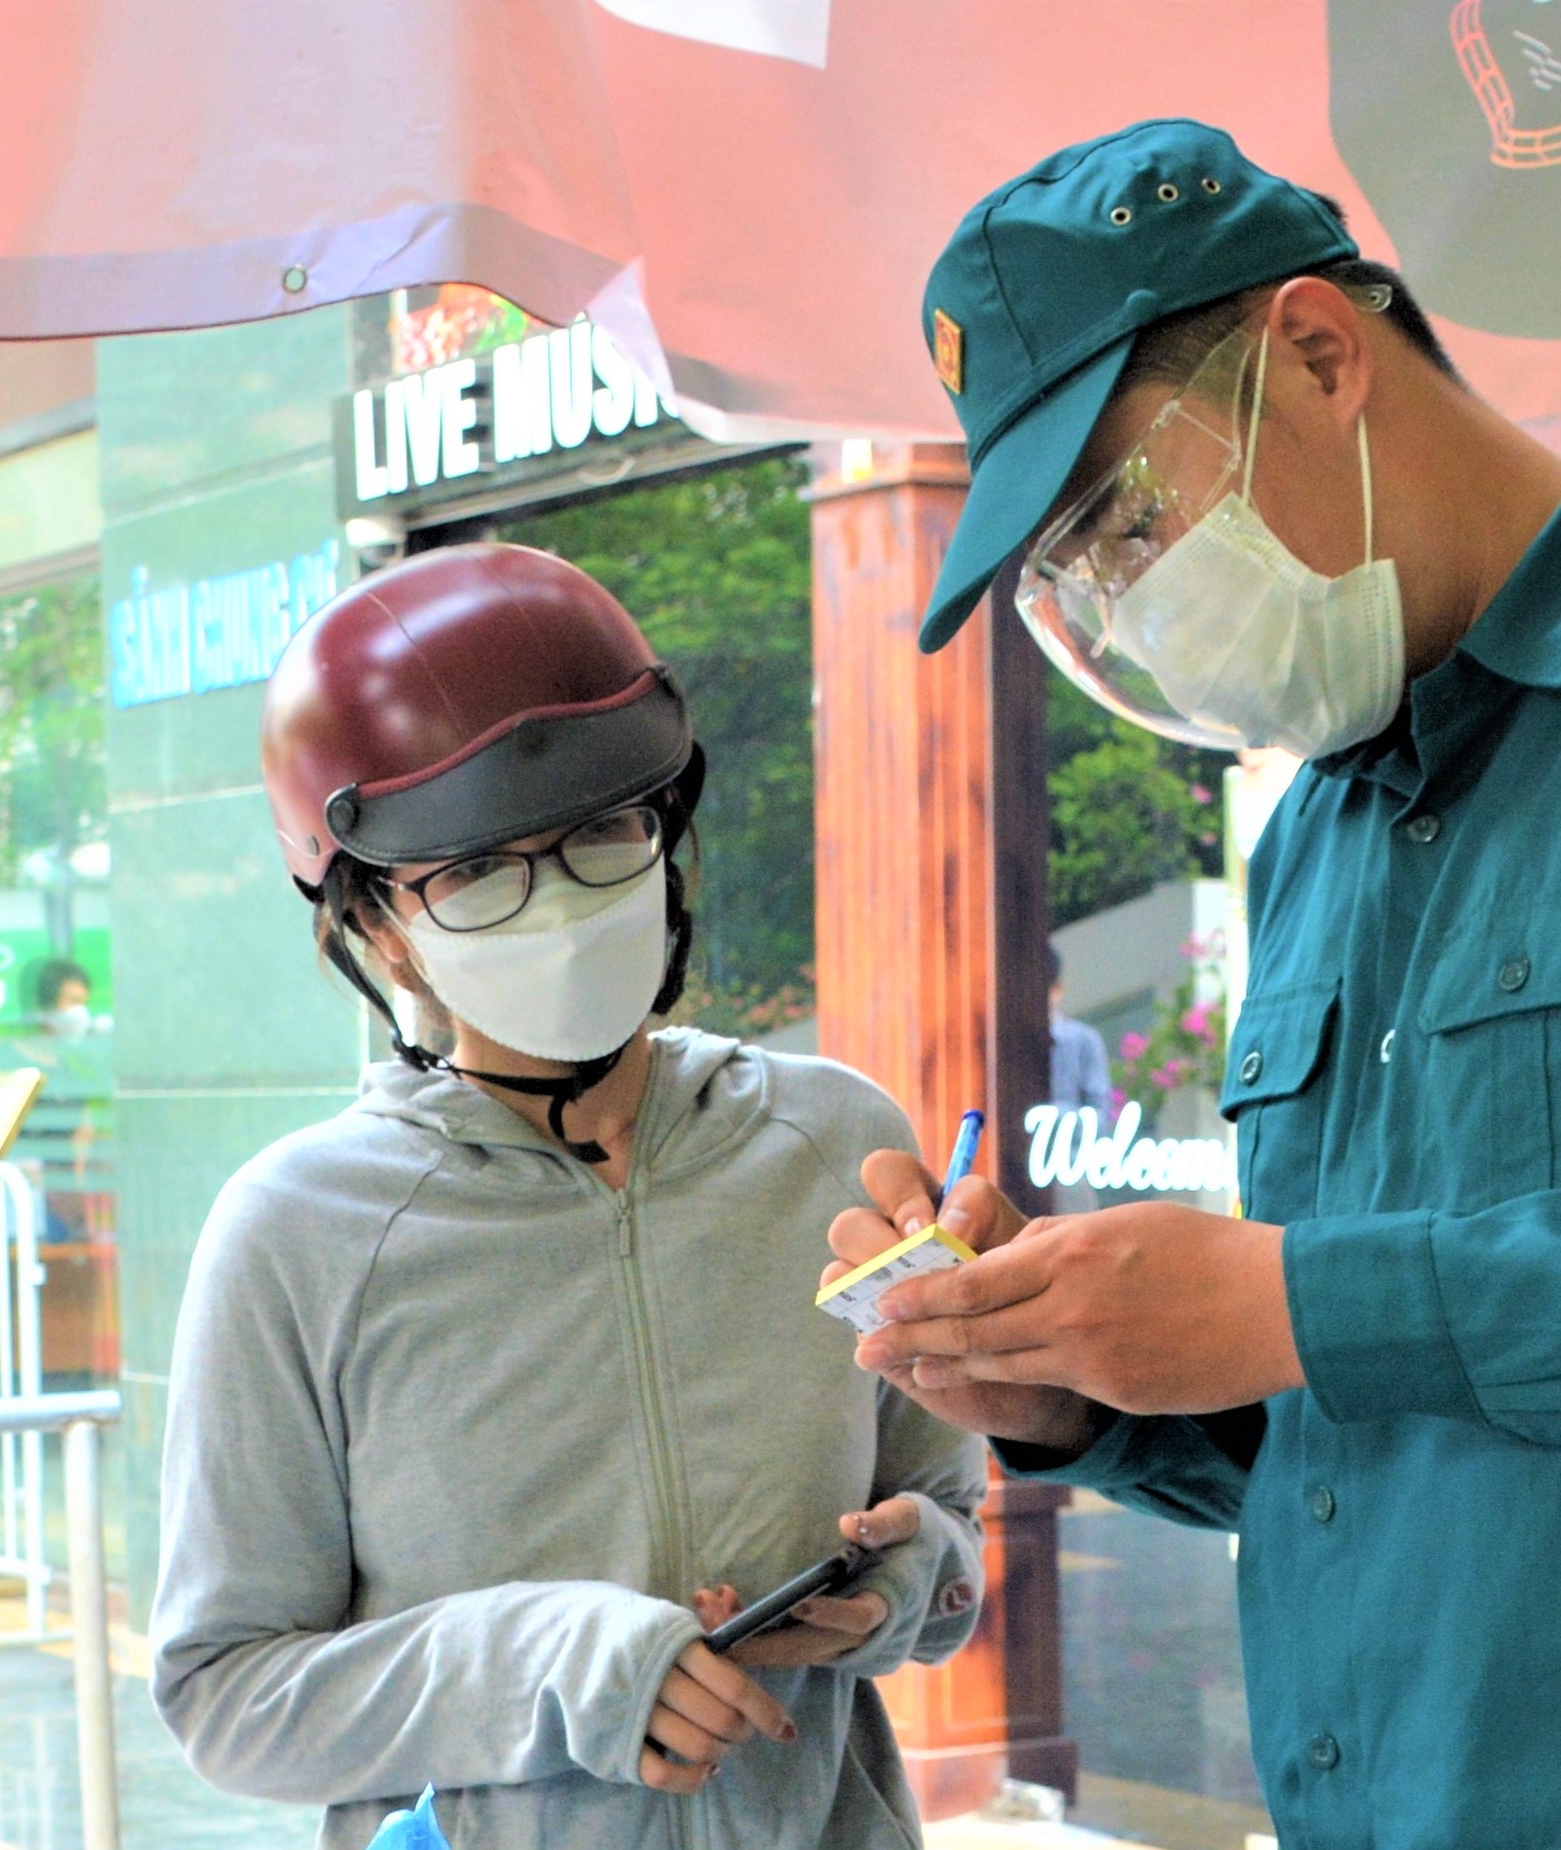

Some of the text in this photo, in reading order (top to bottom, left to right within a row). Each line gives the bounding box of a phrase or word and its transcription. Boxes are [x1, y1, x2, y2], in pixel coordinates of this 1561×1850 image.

[352, 318, 680, 502] LIVE MUS
[1023, 1100, 1237, 1192] Welcom
